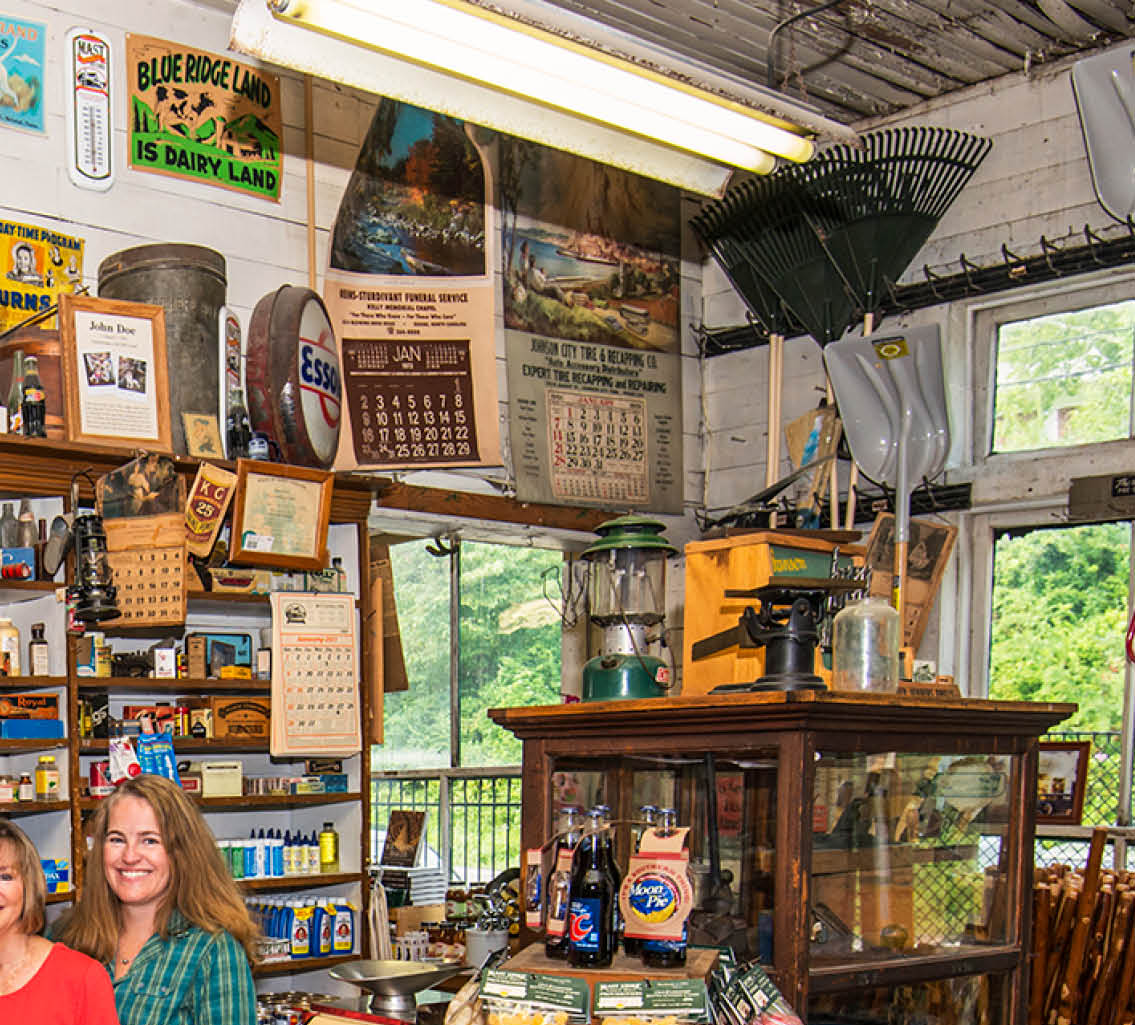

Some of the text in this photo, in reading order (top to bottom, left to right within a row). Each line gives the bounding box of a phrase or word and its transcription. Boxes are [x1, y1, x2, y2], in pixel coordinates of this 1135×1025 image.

[137, 53, 272, 108] BLUE RIDGE LAND
[136, 140, 276, 191] IS DAIRY LAND
[17, 226, 39, 240] TIME
[41, 231, 81, 250] PROGRAM
[405, 292, 468, 303] FUNERAL SERVICE
[89, 320, 136, 336] John Doe
[392, 346, 421, 361] JAN
[562, 344, 644, 367] CITY TIRE RECAPPING
[523, 364, 551, 377] EXPERT
[554, 368, 569, 382] TIRE
[572, 371, 613, 387] RECAPPING
[628, 379, 666, 394] REPAIRING
[376, 411, 466, 425] 10 11 12 13 14 15
[379, 427, 469, 441] 17 18 19 20 21 22
[195, 502, 216, 517] 25
[17, 696, 47, 707] Royal
[631, 882, 665, 896] Moon
[647, 894, 668, 908] Pie
